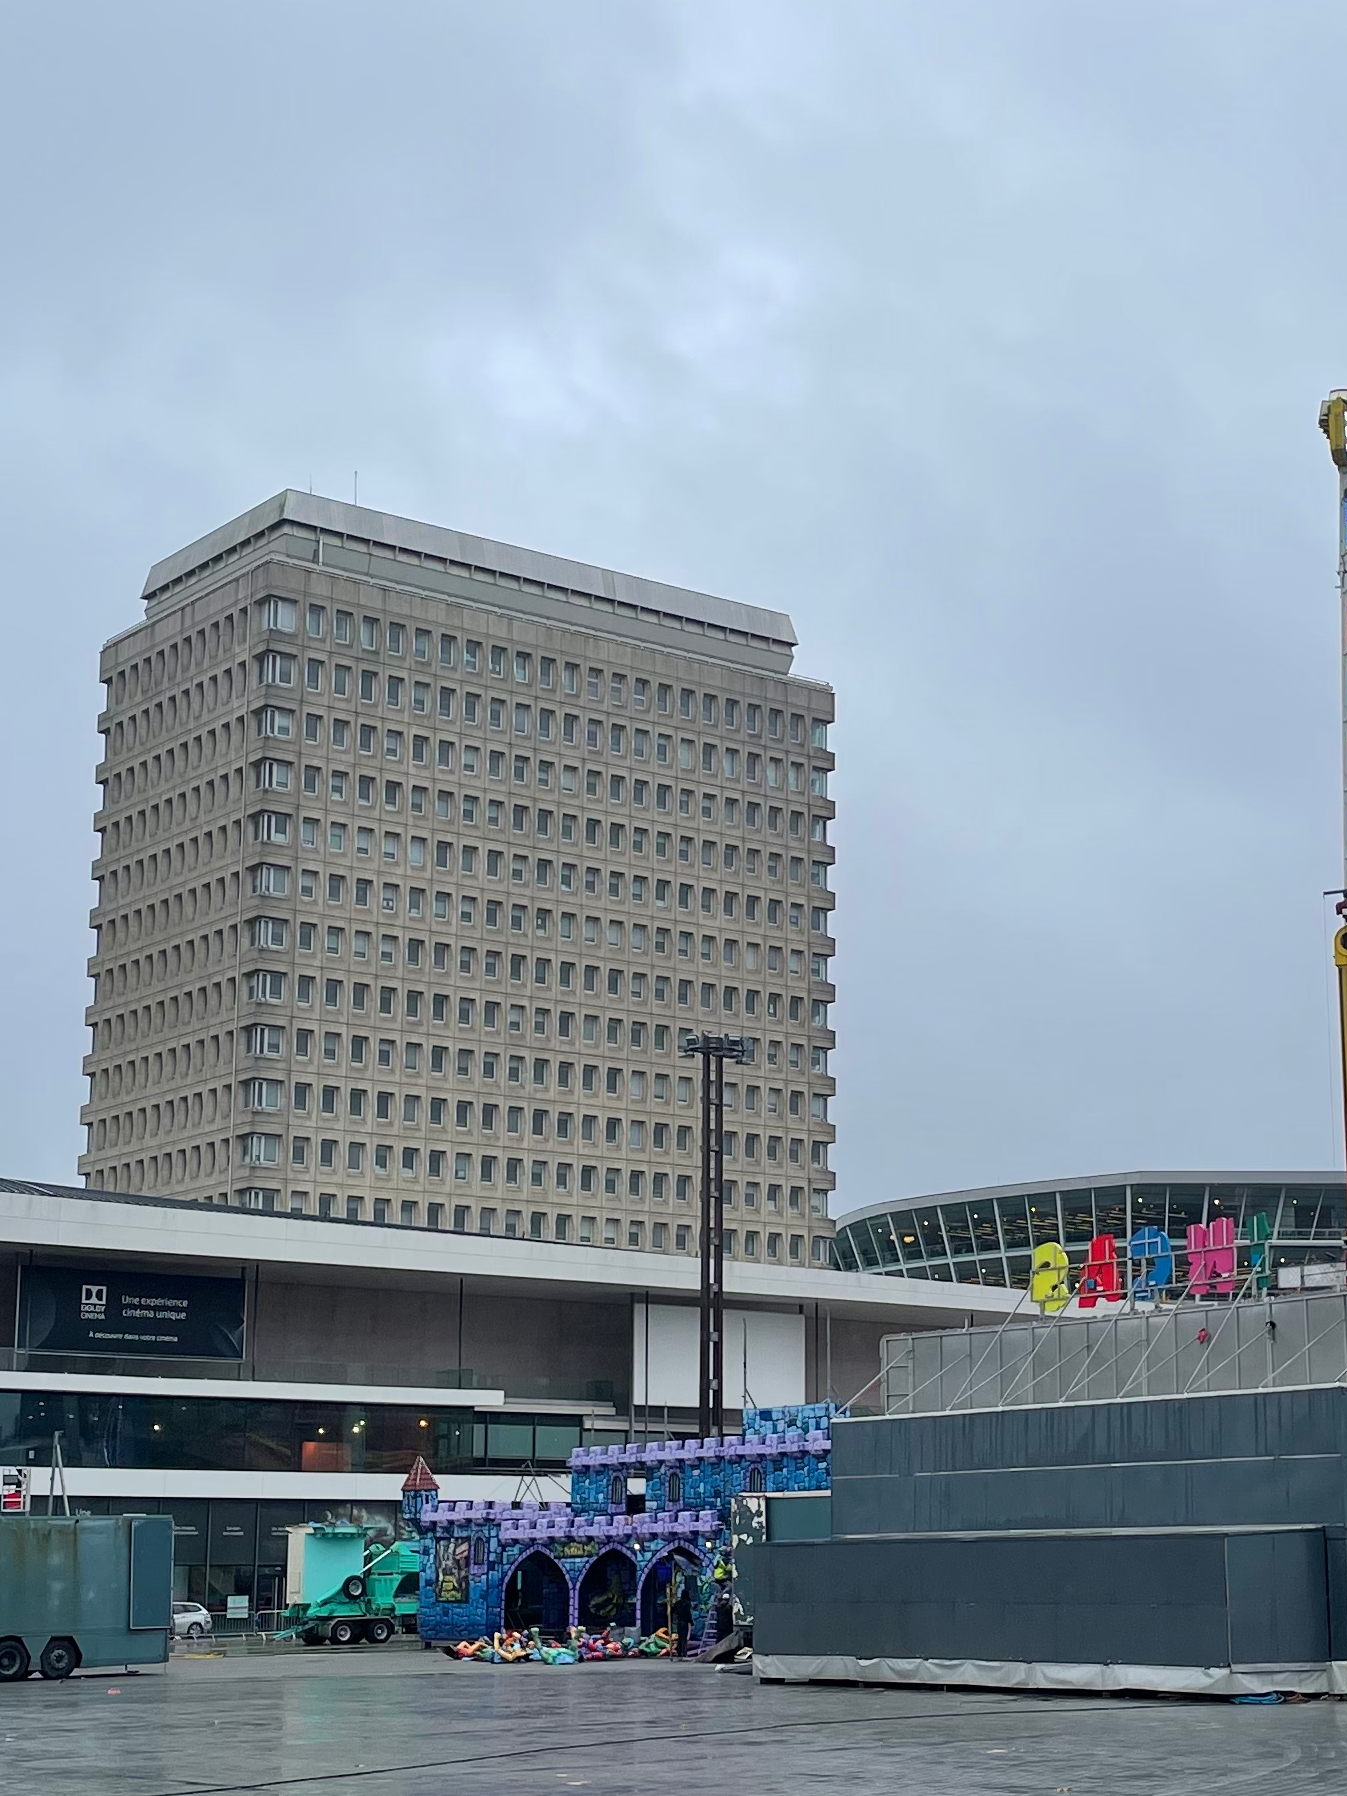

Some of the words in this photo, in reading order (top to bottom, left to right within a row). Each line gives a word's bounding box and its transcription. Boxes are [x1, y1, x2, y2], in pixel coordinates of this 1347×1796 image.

[122, 1295, 139, 1304] Une
[141, 1296, 188, 1308] expérience
[122, 1308, 154, 1317] cinéma
[156, 1311, 186, 1320] unique
